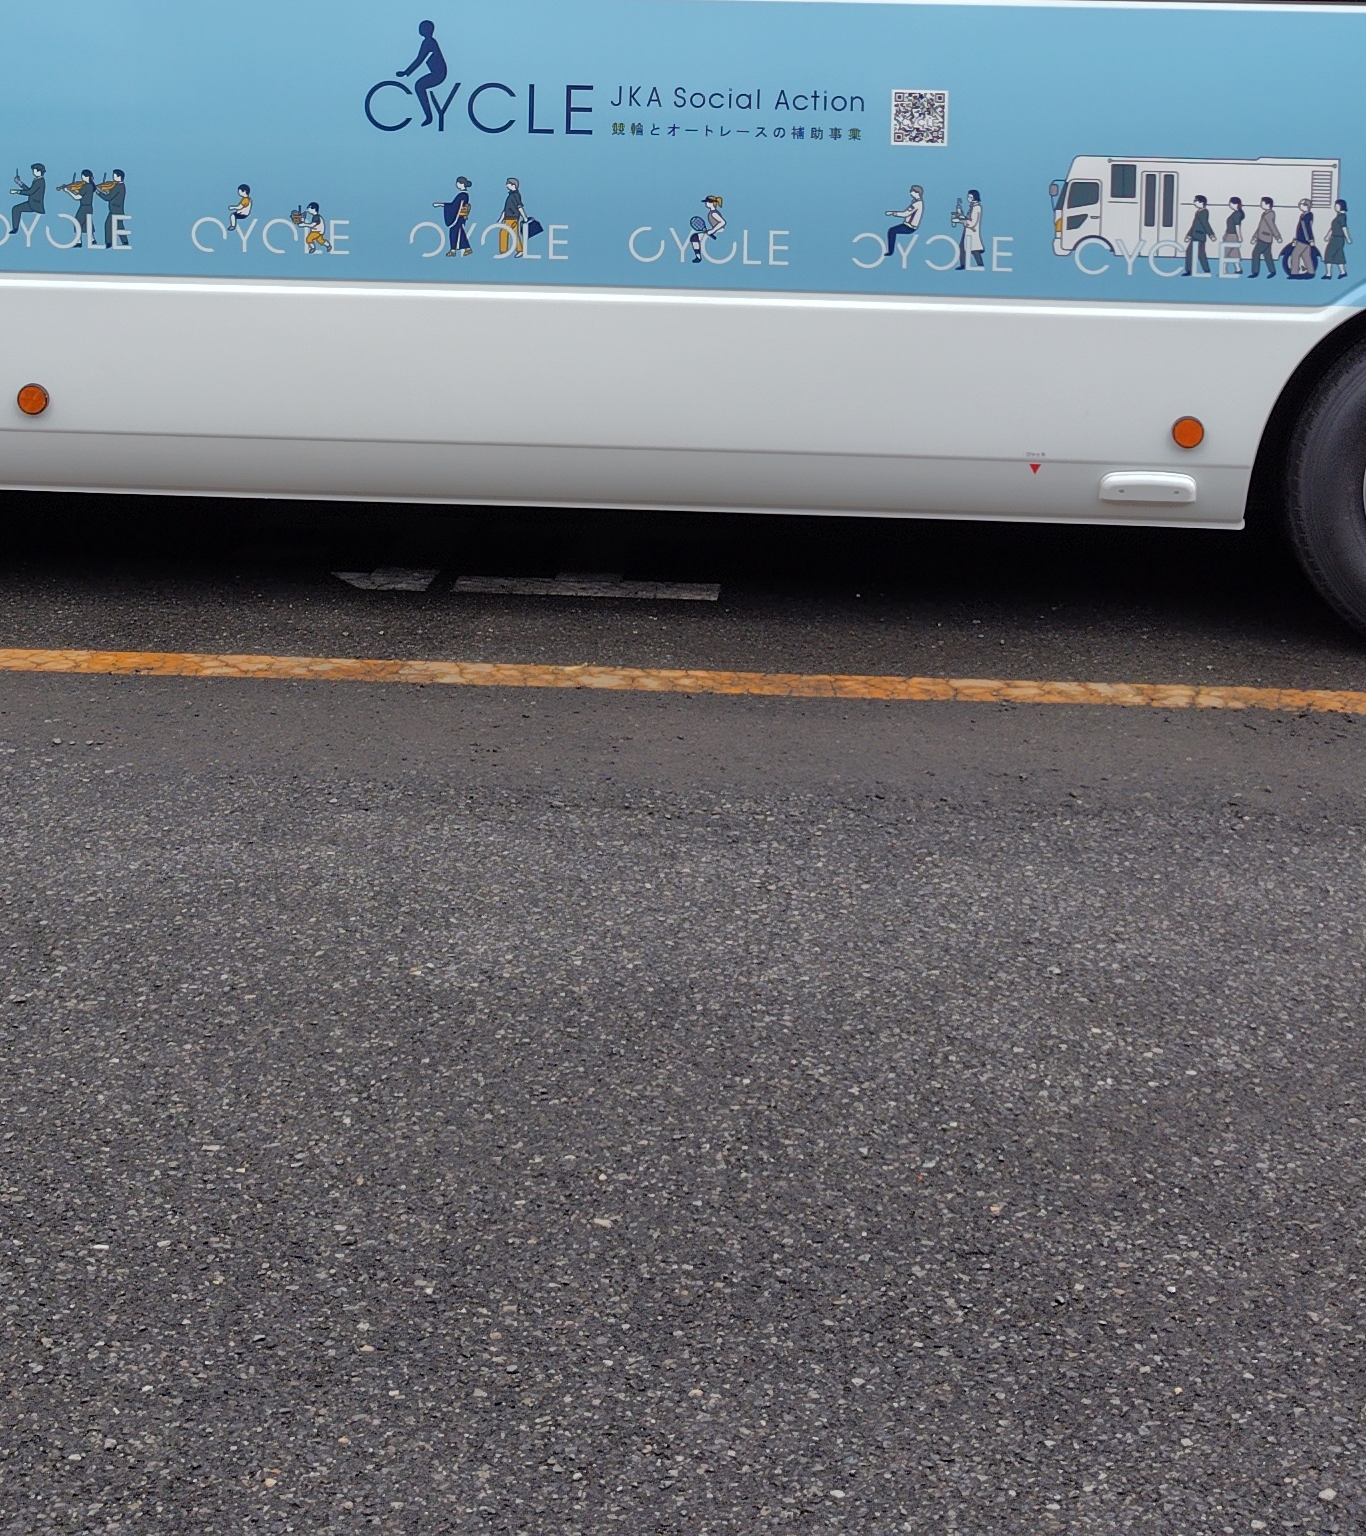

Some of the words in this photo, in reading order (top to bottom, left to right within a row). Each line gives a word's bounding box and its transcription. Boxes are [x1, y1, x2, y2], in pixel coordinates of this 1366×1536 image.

[364, 80, 594, 135] CYCLE
[611, 86, 662, 108] JKA
[673, 87, 761, 110] Social
[775, 89, 865, 112] Action
[1074, 237, 1243, 279] CYCLE
